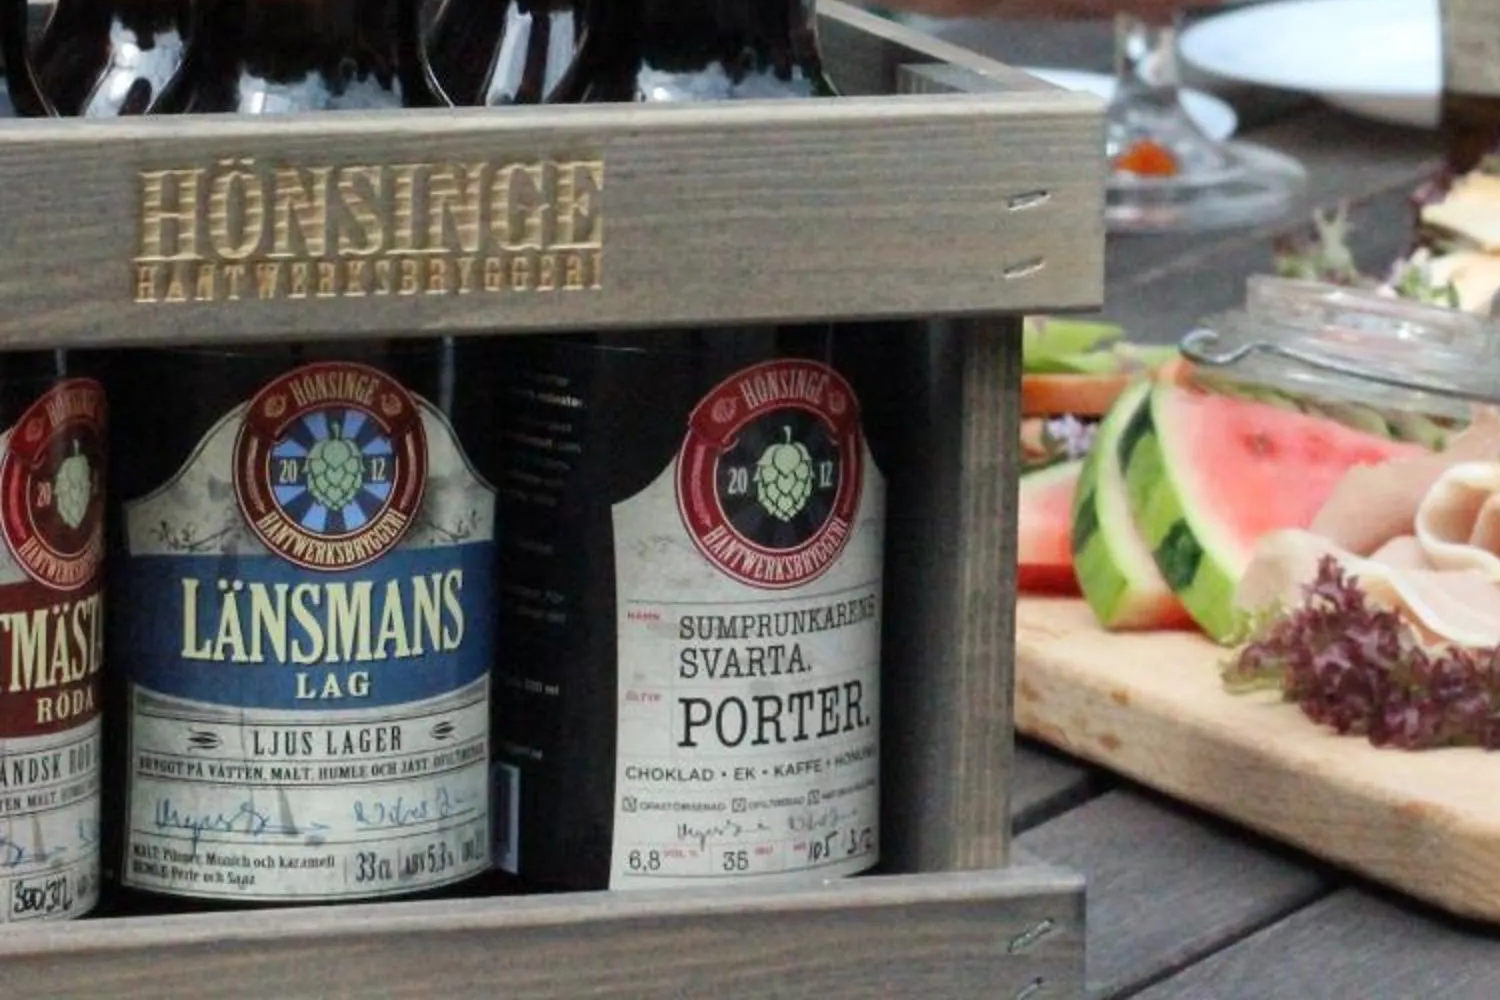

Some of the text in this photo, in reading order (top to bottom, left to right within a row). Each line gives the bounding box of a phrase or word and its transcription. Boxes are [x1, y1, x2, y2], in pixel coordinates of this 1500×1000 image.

[134, 158, 603, 261] HÖNSINGE
[279, 459, 298, 484] 20
[370, 456, 386, 481] 12
[727, 466, 748, 495] 20
[818, 460, 833, 488] 12
[180, 569, 464, 665] LÄNSMANS
[680, 643, 812, 680] SVARTA.
[295, 671, 371, 699] LAG
[677, 679, 871, 748] PORTER.
[253, 724, 401, 756] LJUS LAGER
[625, 766, 715, 782] CHOKLAD
[733, 766, 756, 781] EK
[773, 759, 822, 777] KAFFE
